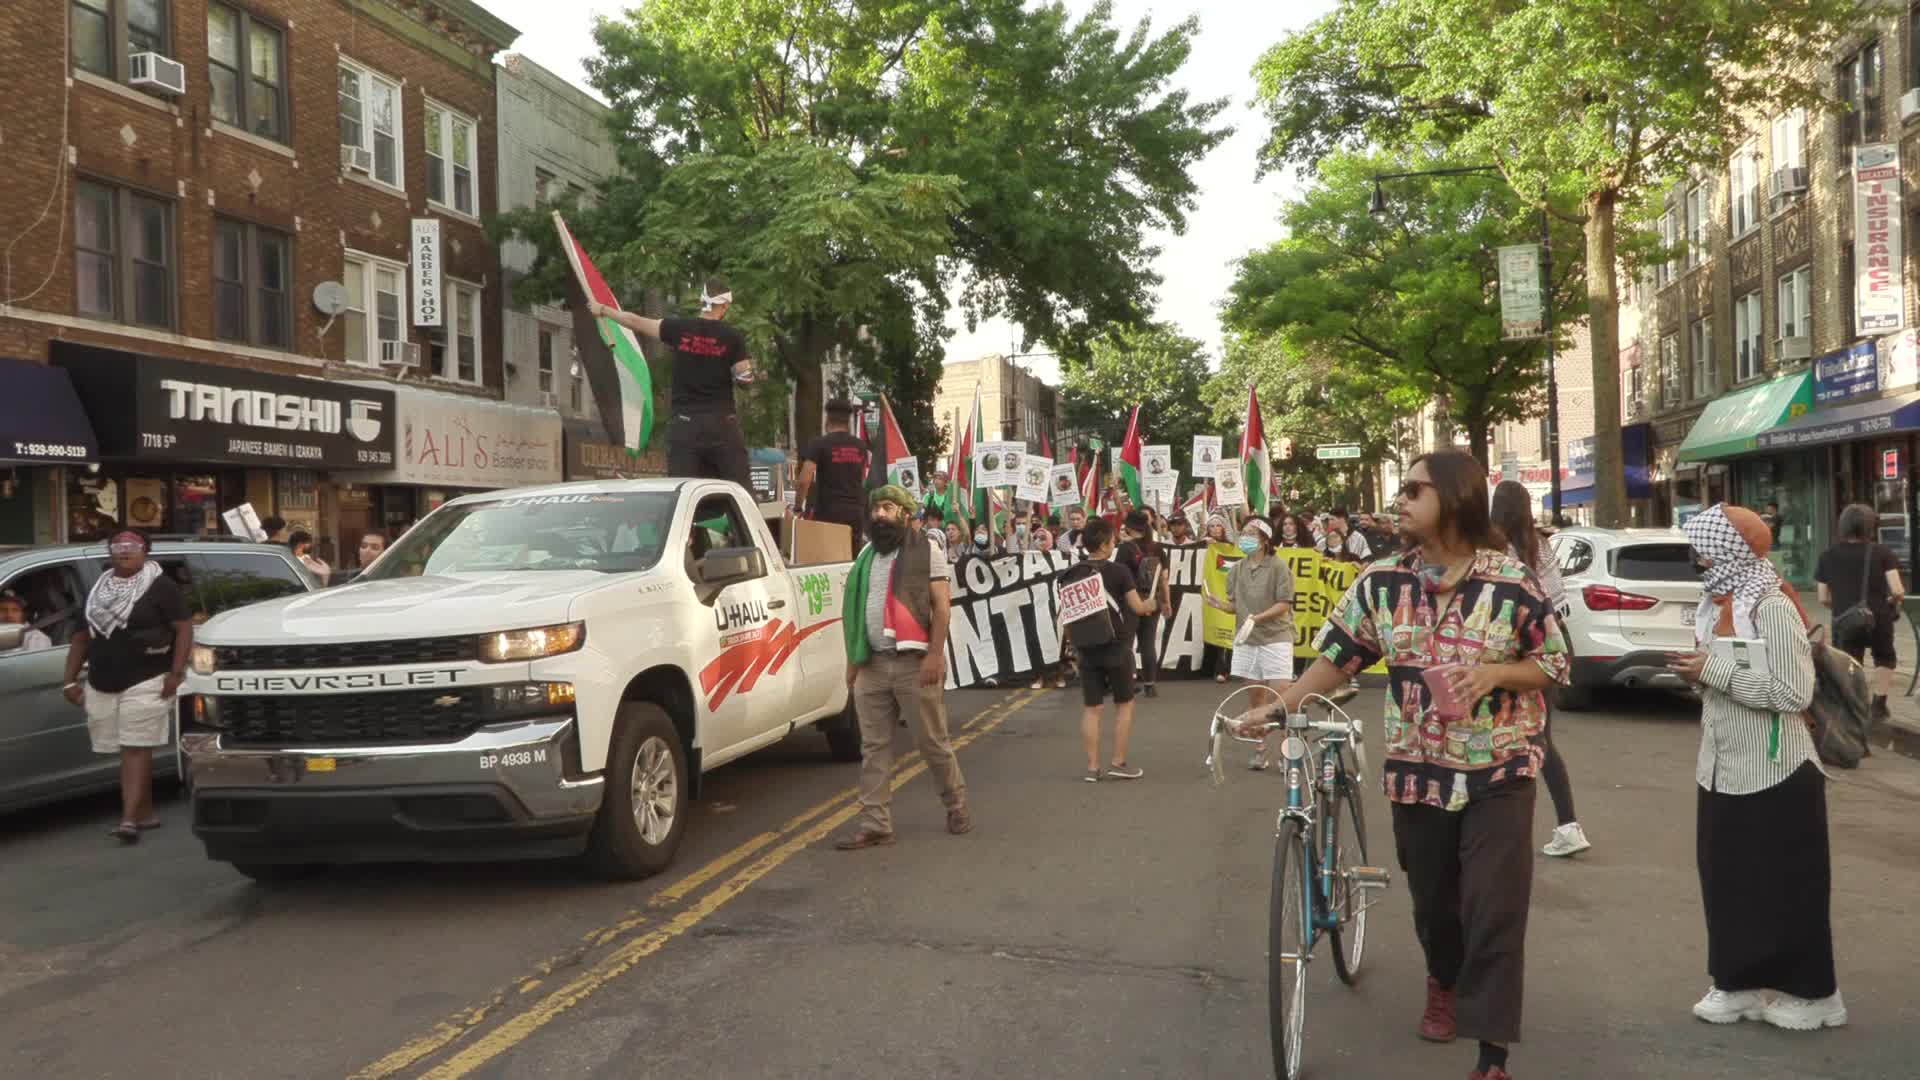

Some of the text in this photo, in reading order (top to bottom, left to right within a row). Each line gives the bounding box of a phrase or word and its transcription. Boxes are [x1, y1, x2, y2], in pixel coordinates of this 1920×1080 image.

[420, 236, 436, 323] BARBER SHOP
[142, 433, 162, 449] 7718
[228, 439, 263, 455] JAPANESE
[263, 441, 288, 457] RAMEN
[295, 444, 323, 459] IZAKAYA
[714, 599, 769, 631] U-HAUL
[216, 668, 468, 692] CHEVROLET
[479, 748, 547, 769] BP 4938 M
